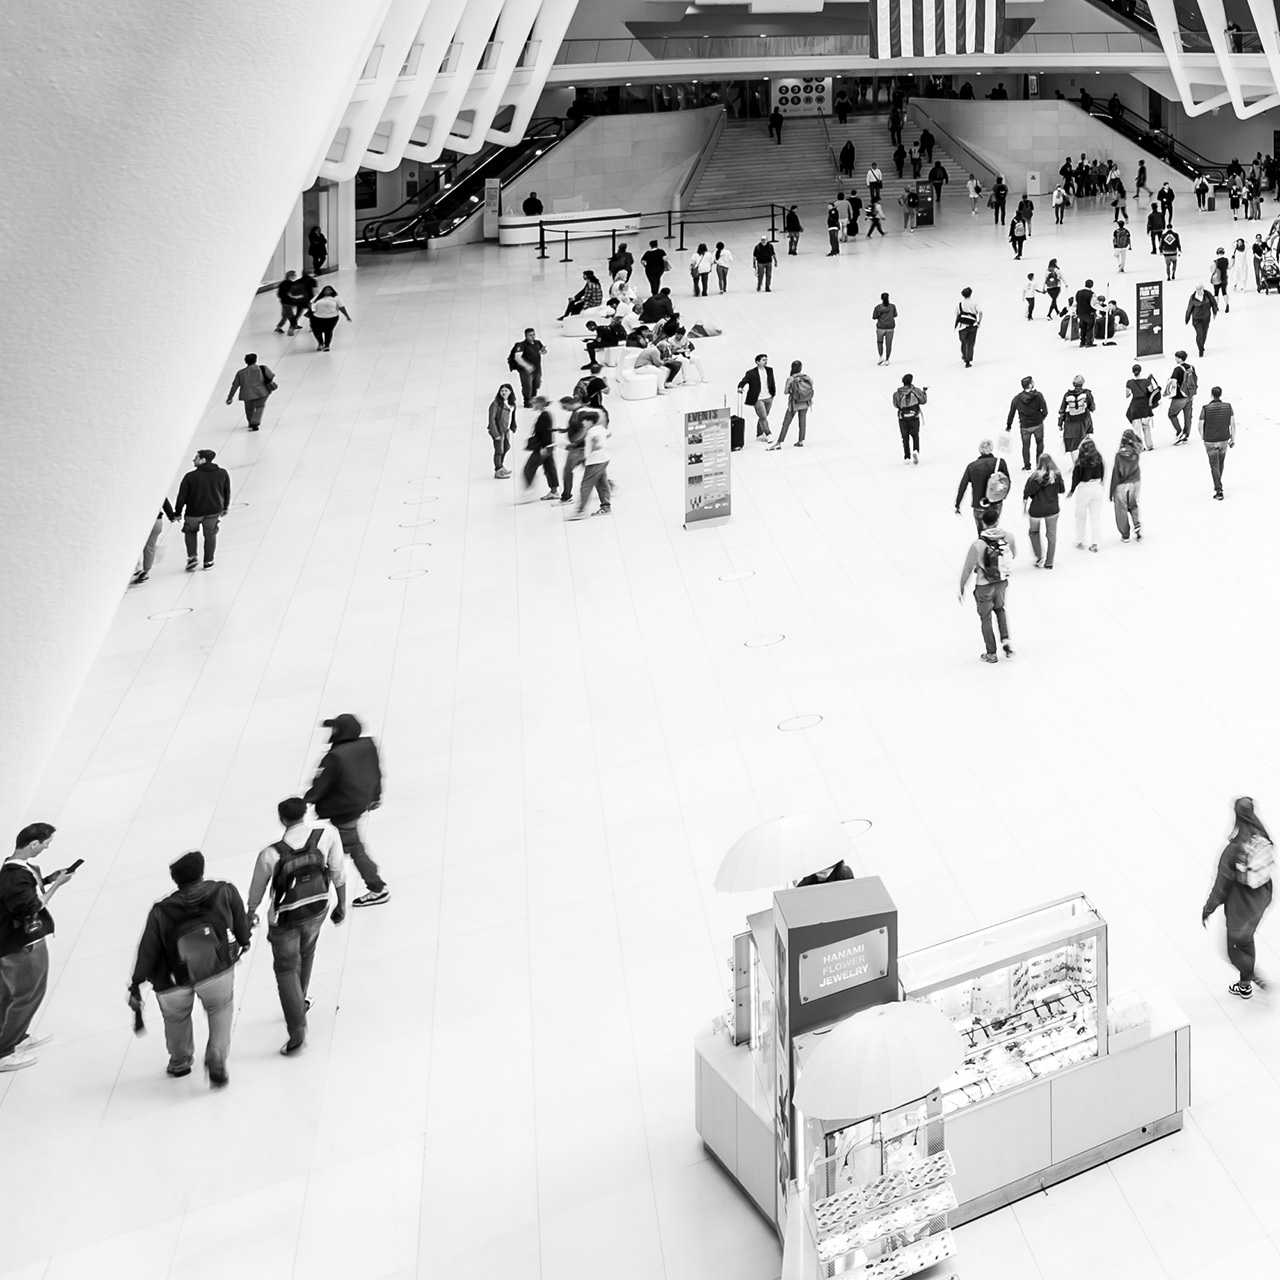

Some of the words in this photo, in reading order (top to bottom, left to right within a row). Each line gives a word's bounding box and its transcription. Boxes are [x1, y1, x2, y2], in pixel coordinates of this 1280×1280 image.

[687, 409, 719, 423] EVENTS
[822, 954, 866, 976] FLOWER
[823, 943, 865, 965] HANAMI
[819, 963, 870, 988] JEWELRY
